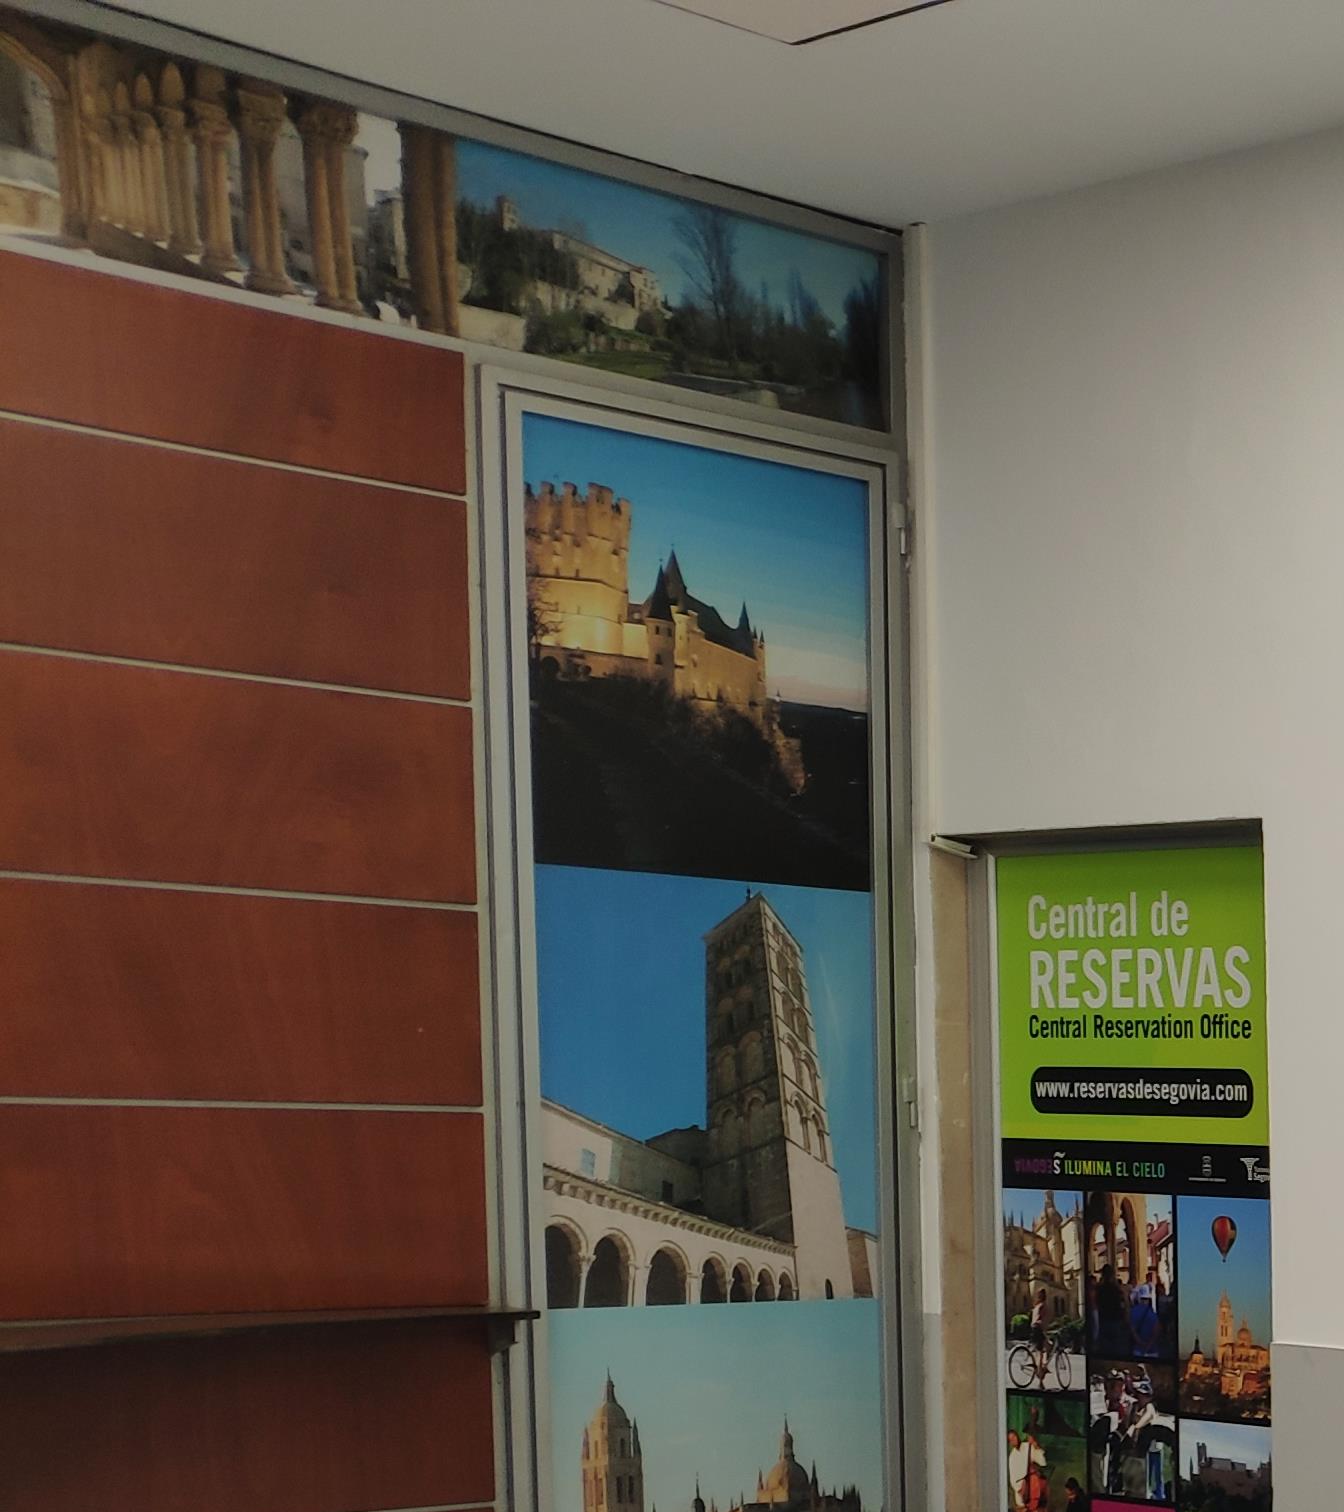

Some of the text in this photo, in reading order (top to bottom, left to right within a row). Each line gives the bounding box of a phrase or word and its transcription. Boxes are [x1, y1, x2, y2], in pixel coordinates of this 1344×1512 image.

[1027, 890, 1189, 939] Central de
[1029, 945, 1251, 1009] RESERVAS
[1029, 1013, 1252, 1040] Central Reservation Office
[1035, 1078, 1248, 1104] www.reservasdesegovia.com
[1064, 1159, 1112, 1177] ILUMINA
[1116, 1161, 1129, 1177] EL
[1133, 1162, 1166, 1179] CIELO
